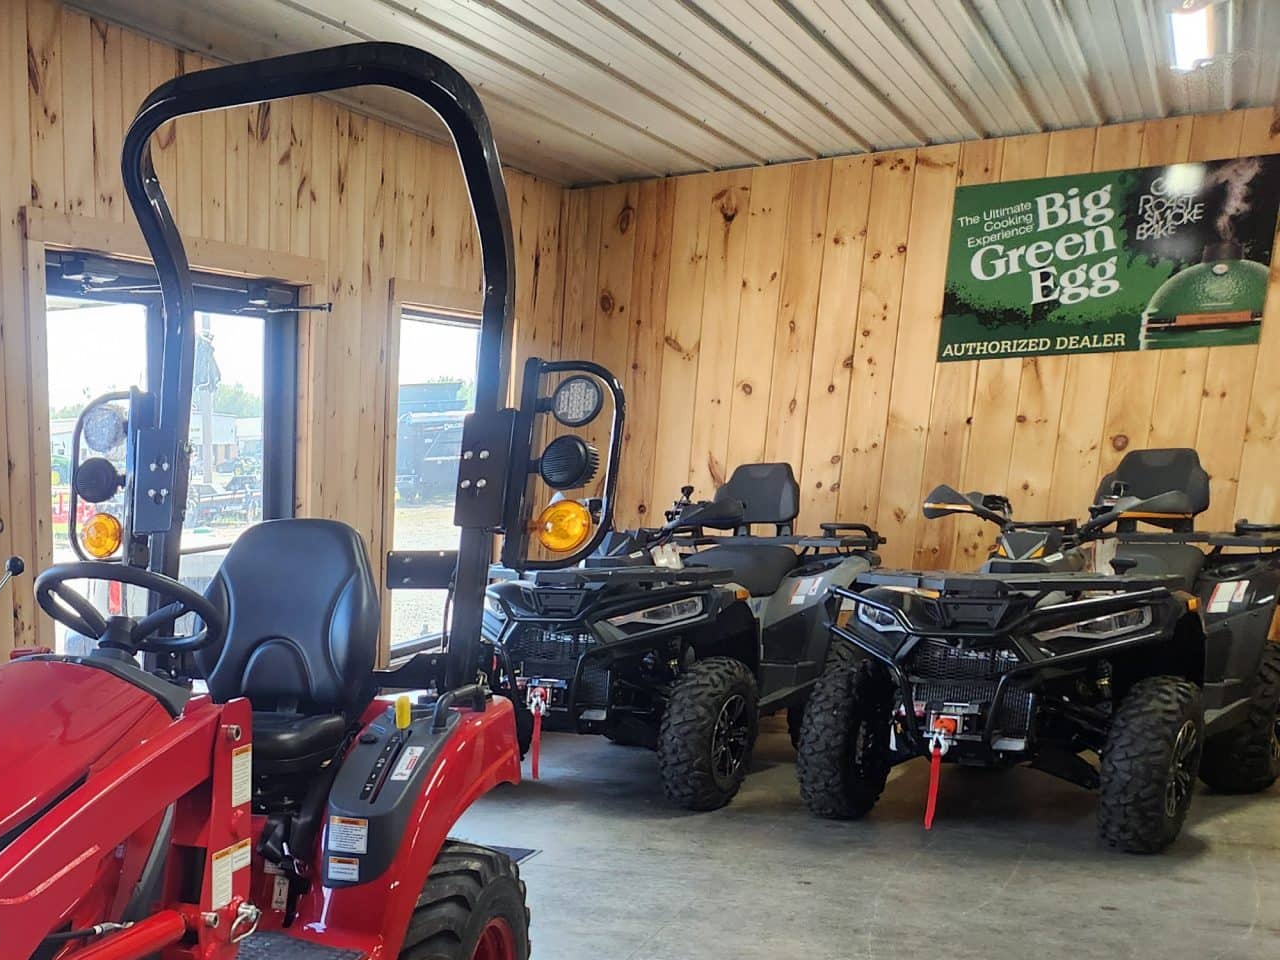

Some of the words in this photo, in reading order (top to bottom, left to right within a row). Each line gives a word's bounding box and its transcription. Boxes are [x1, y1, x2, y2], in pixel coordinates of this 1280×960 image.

[957, 215, 981, 228] The
[983, 202, 1032, 221] Ultimate
[1035, 183, 1115, 232] Big
[1144, 203, 1205, 227] SMOKE
[984, 213, 1033, 232] Cooking
[1136, 221, 1177, 240] BAKE
[967, 224, 1034, 248] Experience
[970, 225, 1118, 281] Green
[1028, 255, 1121, 305] Egg
[942, 338, 1051, 357] AUTHORIZED
[1055, 332, 1126, 350] DEALER
